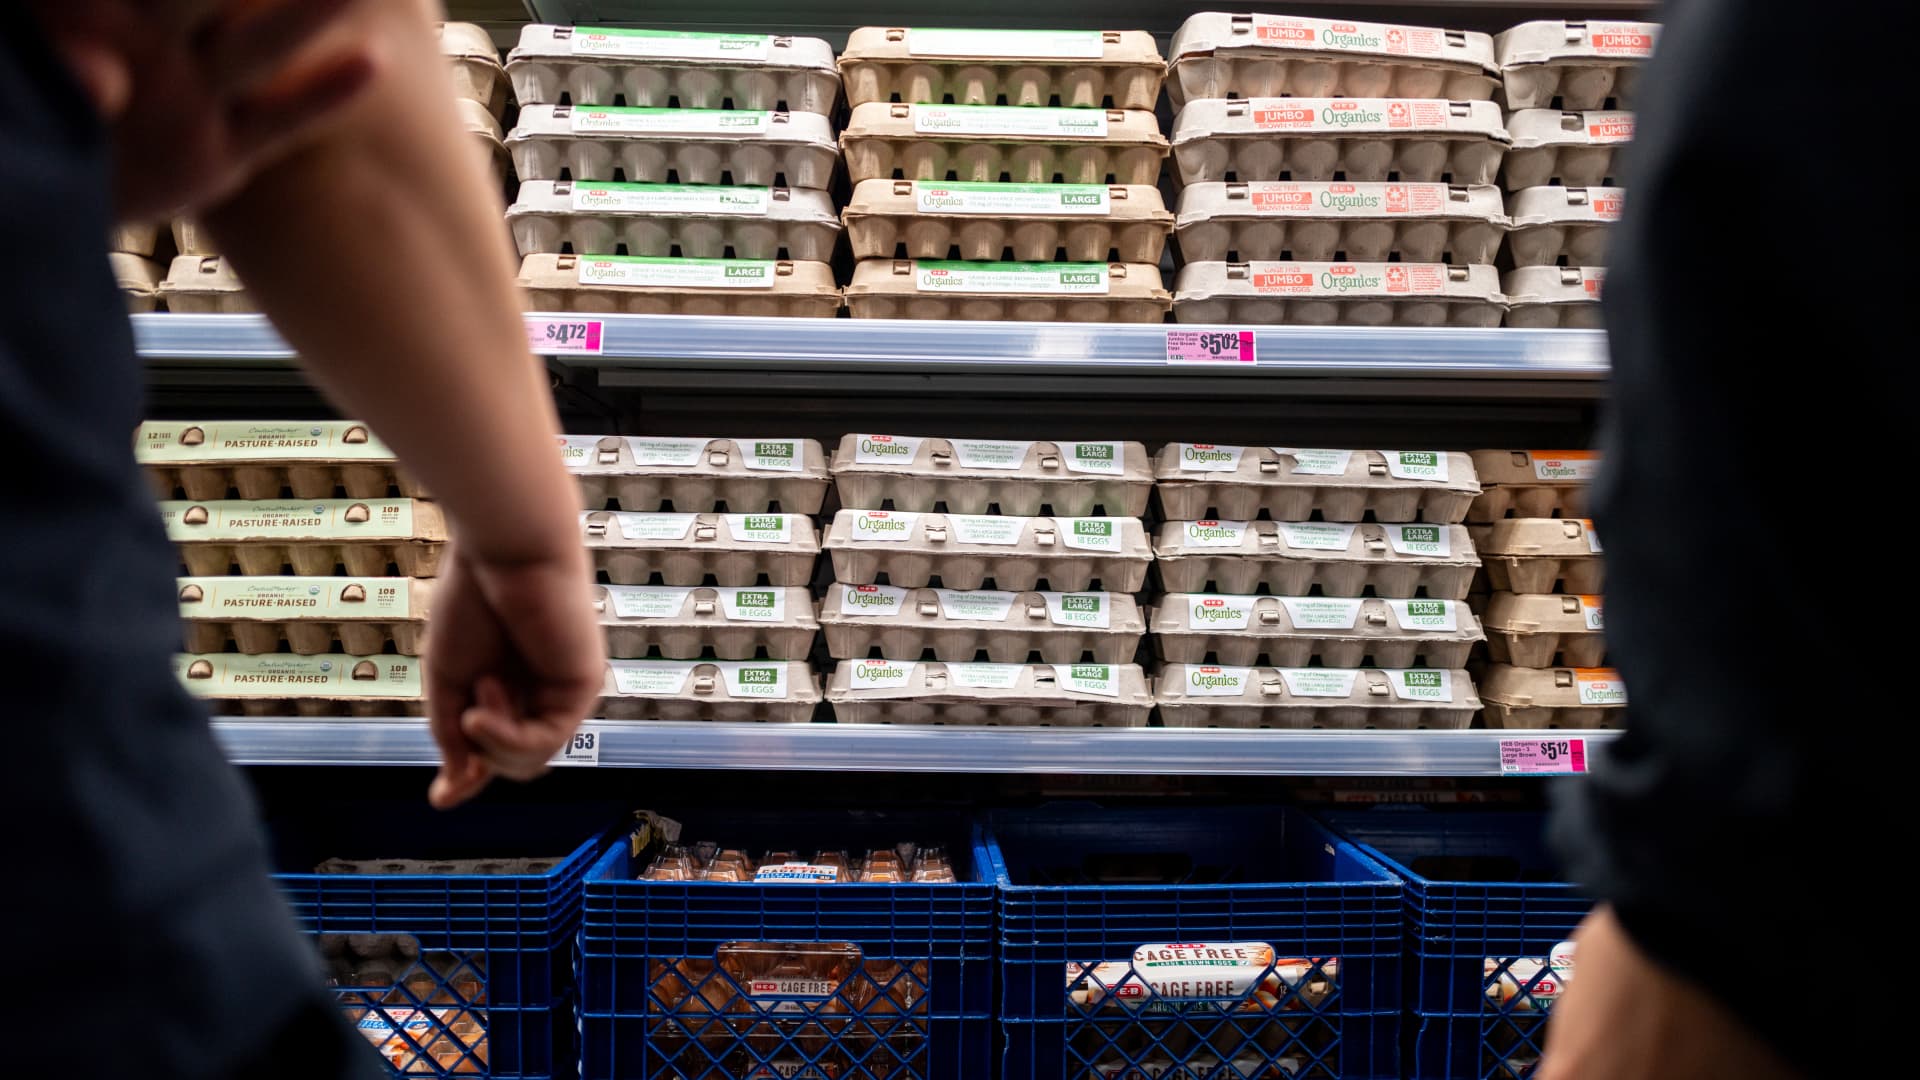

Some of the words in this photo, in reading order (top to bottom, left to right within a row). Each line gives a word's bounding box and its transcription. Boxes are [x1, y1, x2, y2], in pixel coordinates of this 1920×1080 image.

[1267, 28, 1305, 38] JUMBO
[1322, 29, 1379, 48] Organics
[580, 38, 620, 51] Organics
[1602, 36, 1640, 46] JUMBO
[1264, 110, 1304, 122] JUMBO
[1322, 108, 1380, 127] Organics
[580, 117, 620, 130] Organics
[581, 194, 621, 208] Organics
[924, 195, 964, 208] Organics
[1064, 195, 1097, 204] LARGE
[1262, 193, 1302, 202] JUMBO
[1320, 190, 1378, 212] Organics
[586, 266, 626, 280] Organics
[728, 268, 762, 276] LARGE
[924, 274, 963, 288] Organics
[1064, 275, 1096, 284] LARGE
[1263, 275, 1304, 285] JUMBO
[1321, 272, 1379, 292] Organics
[862, 440, 909, 456] Organics
[1185, 447, 1232, 464] Organics
[767, 459, 792, 467] EGGS
[1088, 460, 1112, 469] EGGS
[1413, 467, 1436, 476] EGGS
[1541, 466, 1576, 478] Organics
[858, 516, 905, 532] Organics
[756, 532, 780, 540] EGGS
[1190, 526, 1236, 541] Organics
[1087, 536, 1110, 545] EGGS
[1415, 544, 1439, 552] EGGS
[848, 590, 894, 608] Organics
[748, 608, 772, 617] EGGS
[1074, 613, 1097, 622] EGGS
[1195, 606, 1242, 622] Organics
[1421, 617, 1445, 625] EGGS
[857, 664, 903, 682] Organics
[1084, 680, 1107, 690] EGGS
[1192, 672, 1238, 689] Organics
[751, 686, 775, 694] EGGS
[1418, 688, 1440, 697] EGGS
[1586, 688, 1624, 702] Organics
[1134, 950, 1187, 962] CAGE
[1194, 948, 1248, 960] FREE
[782, 982, 806, 992] CAGE
[808, 983, 832, 993] FREE
[1151, 982, 1190, 997] CAGE
[1196, 981, 1235, 997] FREE
